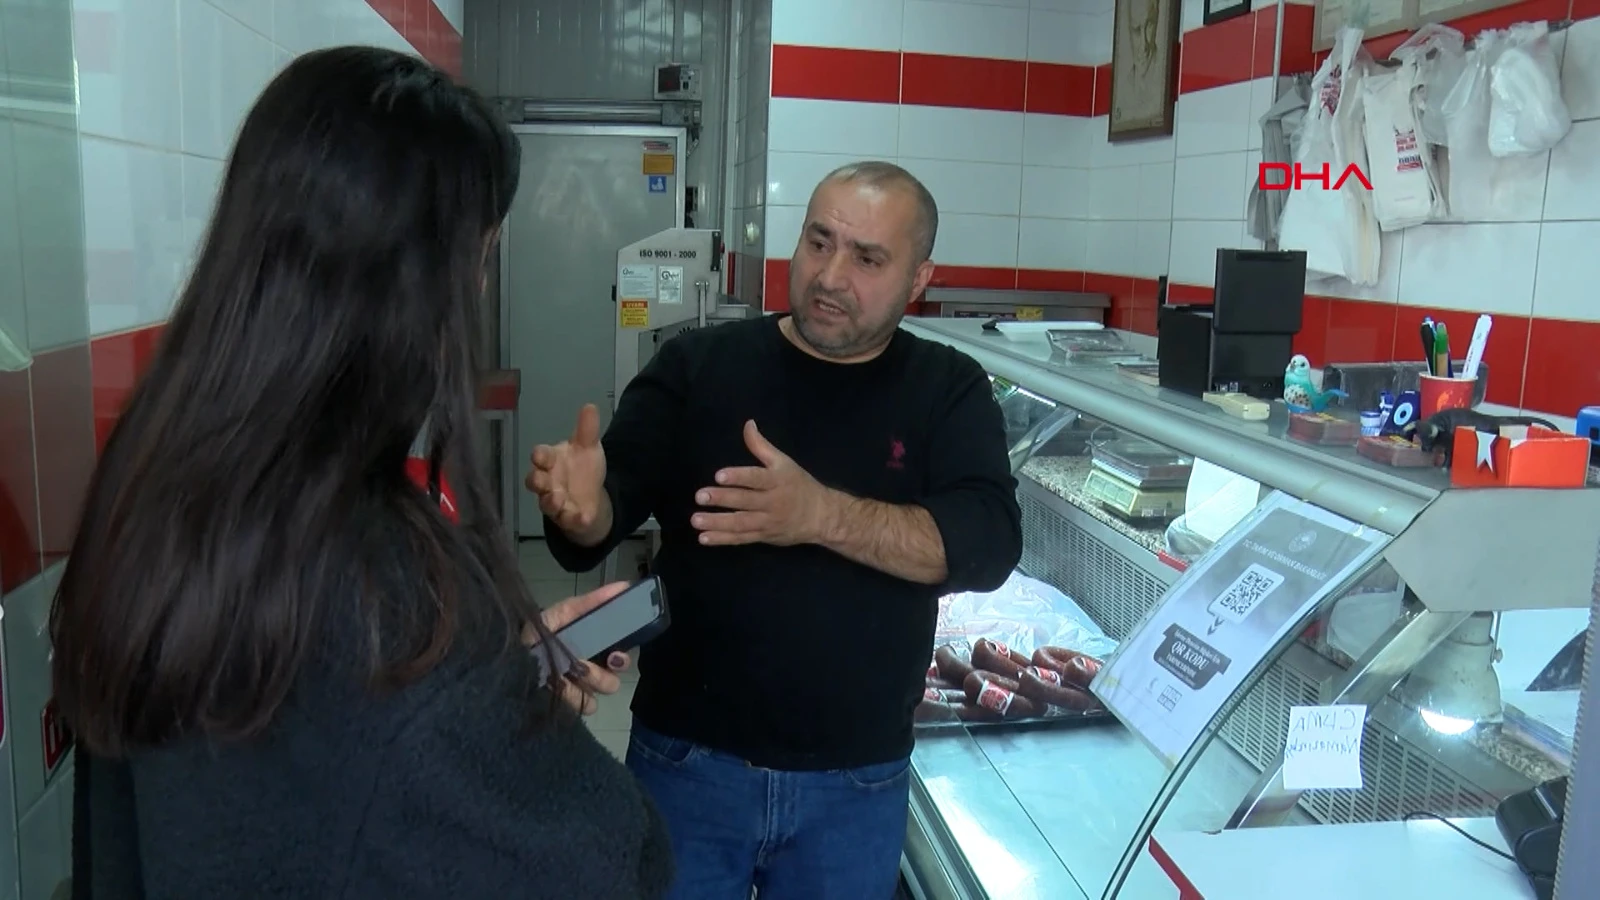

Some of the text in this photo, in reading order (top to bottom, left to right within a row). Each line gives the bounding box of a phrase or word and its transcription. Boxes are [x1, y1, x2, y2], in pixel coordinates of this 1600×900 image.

[640, 249, 653, 258] ISO
[654, 250, 672, 258] 9001
[679, 250, 697, 259] 2000
[1171, 640, 1187, 655] QR
[1183, 648, 1210, 670] KODU
